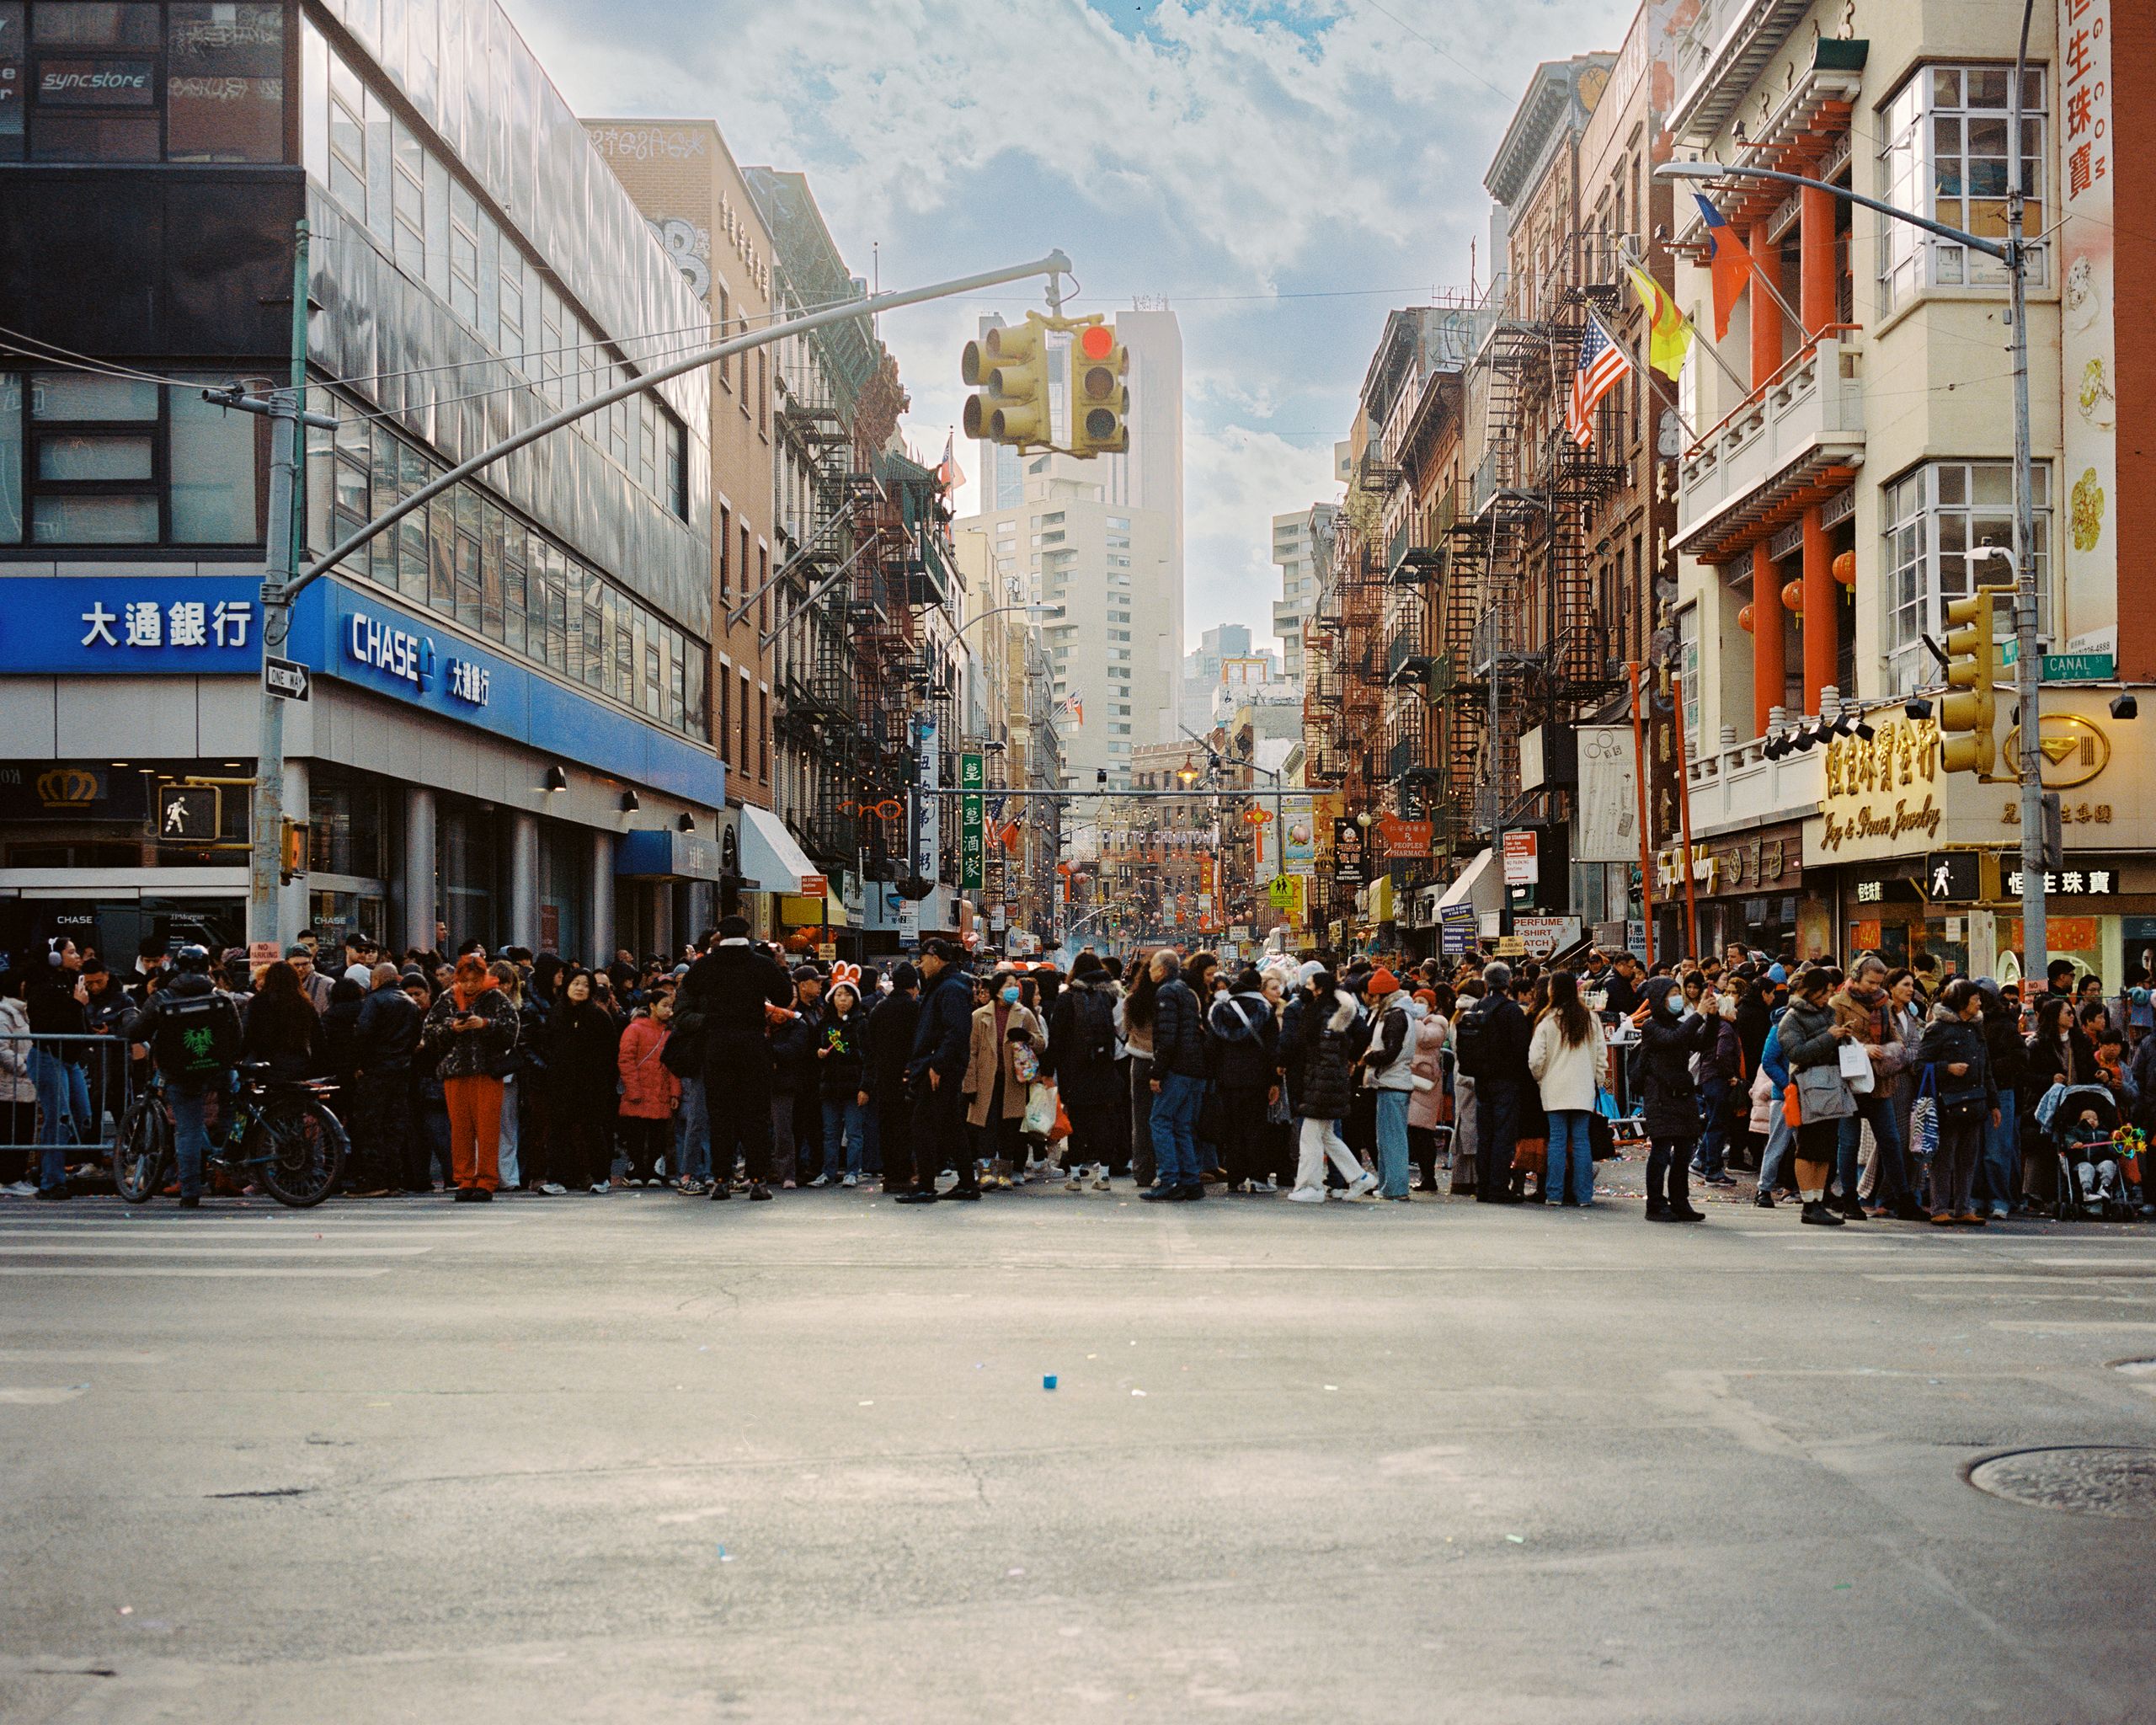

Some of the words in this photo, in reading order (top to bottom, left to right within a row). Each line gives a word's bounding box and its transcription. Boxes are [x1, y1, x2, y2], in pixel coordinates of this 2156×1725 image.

[42, 72, 146, 90] syncstore
[82, 601, 251, 647] 大通銀行
[352, 613, 419, 682] CHASE
[2050, 658, 2090, 671] CANAL
[271, 669, 285, 686] ONE
[290, 673, 303, 690] WAY
[453, 658, 489, 707] 大通銀行
[1890, 793, 1940, 841] Jewelry
[314, 916, 346, 925] CHASE
[1514, 917, 1563, 927] PERFUME
